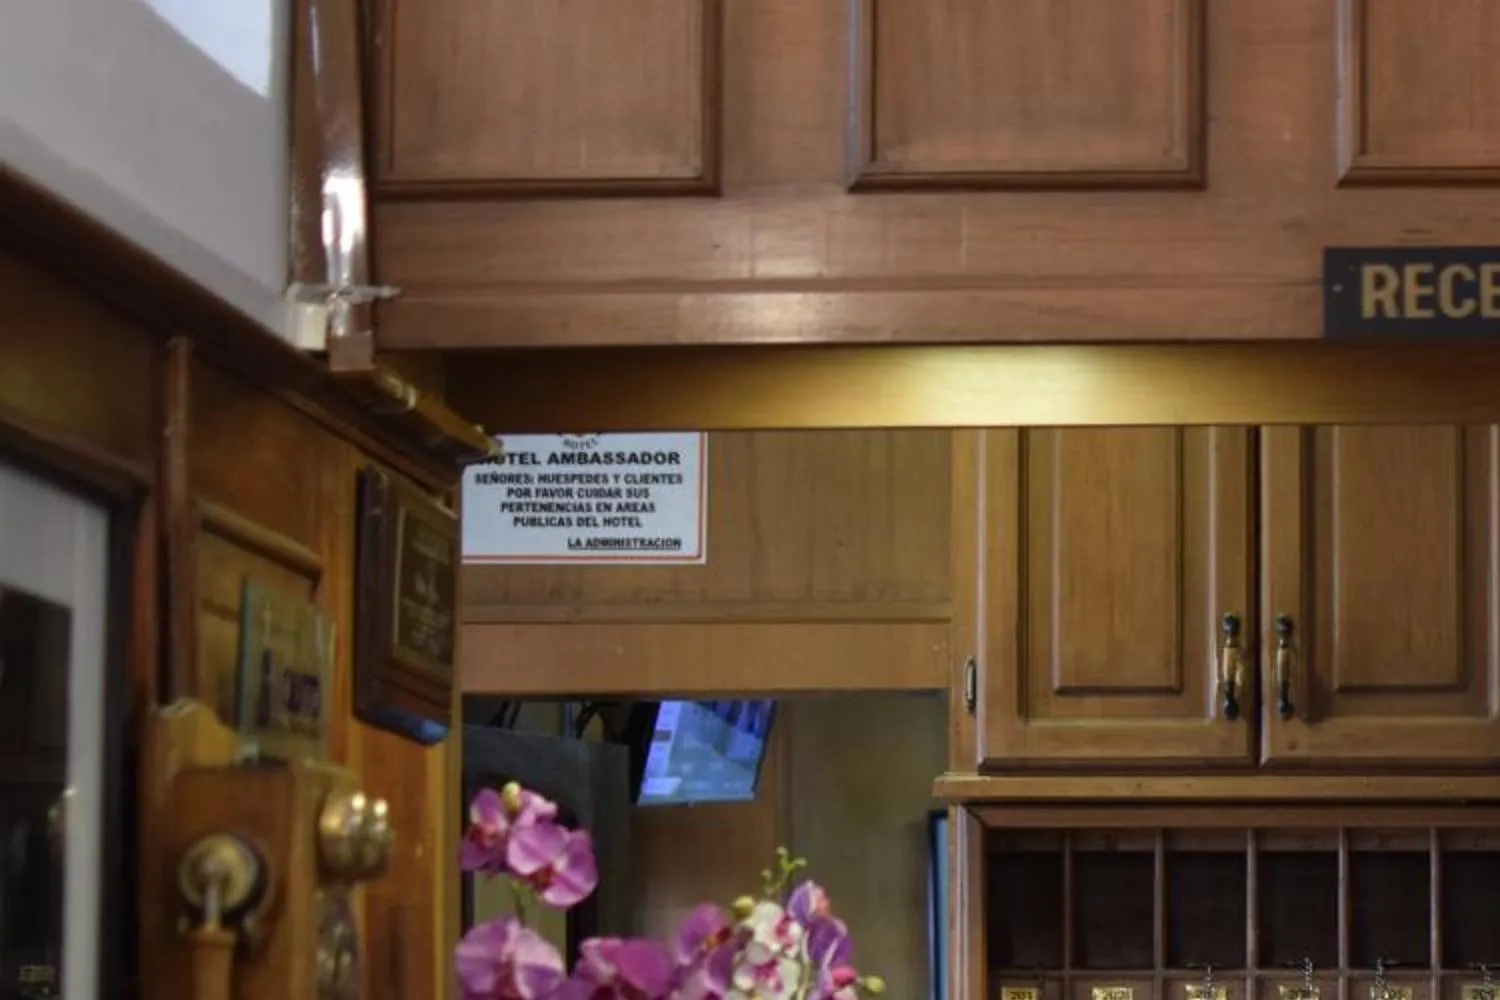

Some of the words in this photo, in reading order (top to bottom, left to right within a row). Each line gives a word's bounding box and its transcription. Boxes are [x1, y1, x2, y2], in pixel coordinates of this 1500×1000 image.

[547, 451, 681, 465] AMBASSADOR
[537, 473, 609, 485] HUESPEDES
[613, 473, 621, 484] Y
[624, 473, 683, 485] CLIENTES
[506, 487, 532, 499] POR
[535, 487, 574, 499] FAVOR
[577, 487, 622, 499] CUIDAR
[625, 487, 650, 499] SUS
[501, 501, 592, 513] PERTENENCIAS
[595, 501, 614, 513] EN
[616, 501, 655, 513] AREAS
[513, 516, 573, 528] PUBLICAS
[576, 516, 599, 528] DEL
[602, 516, 643, 528] HOTEL
[567, 537, 582, 548] LA
